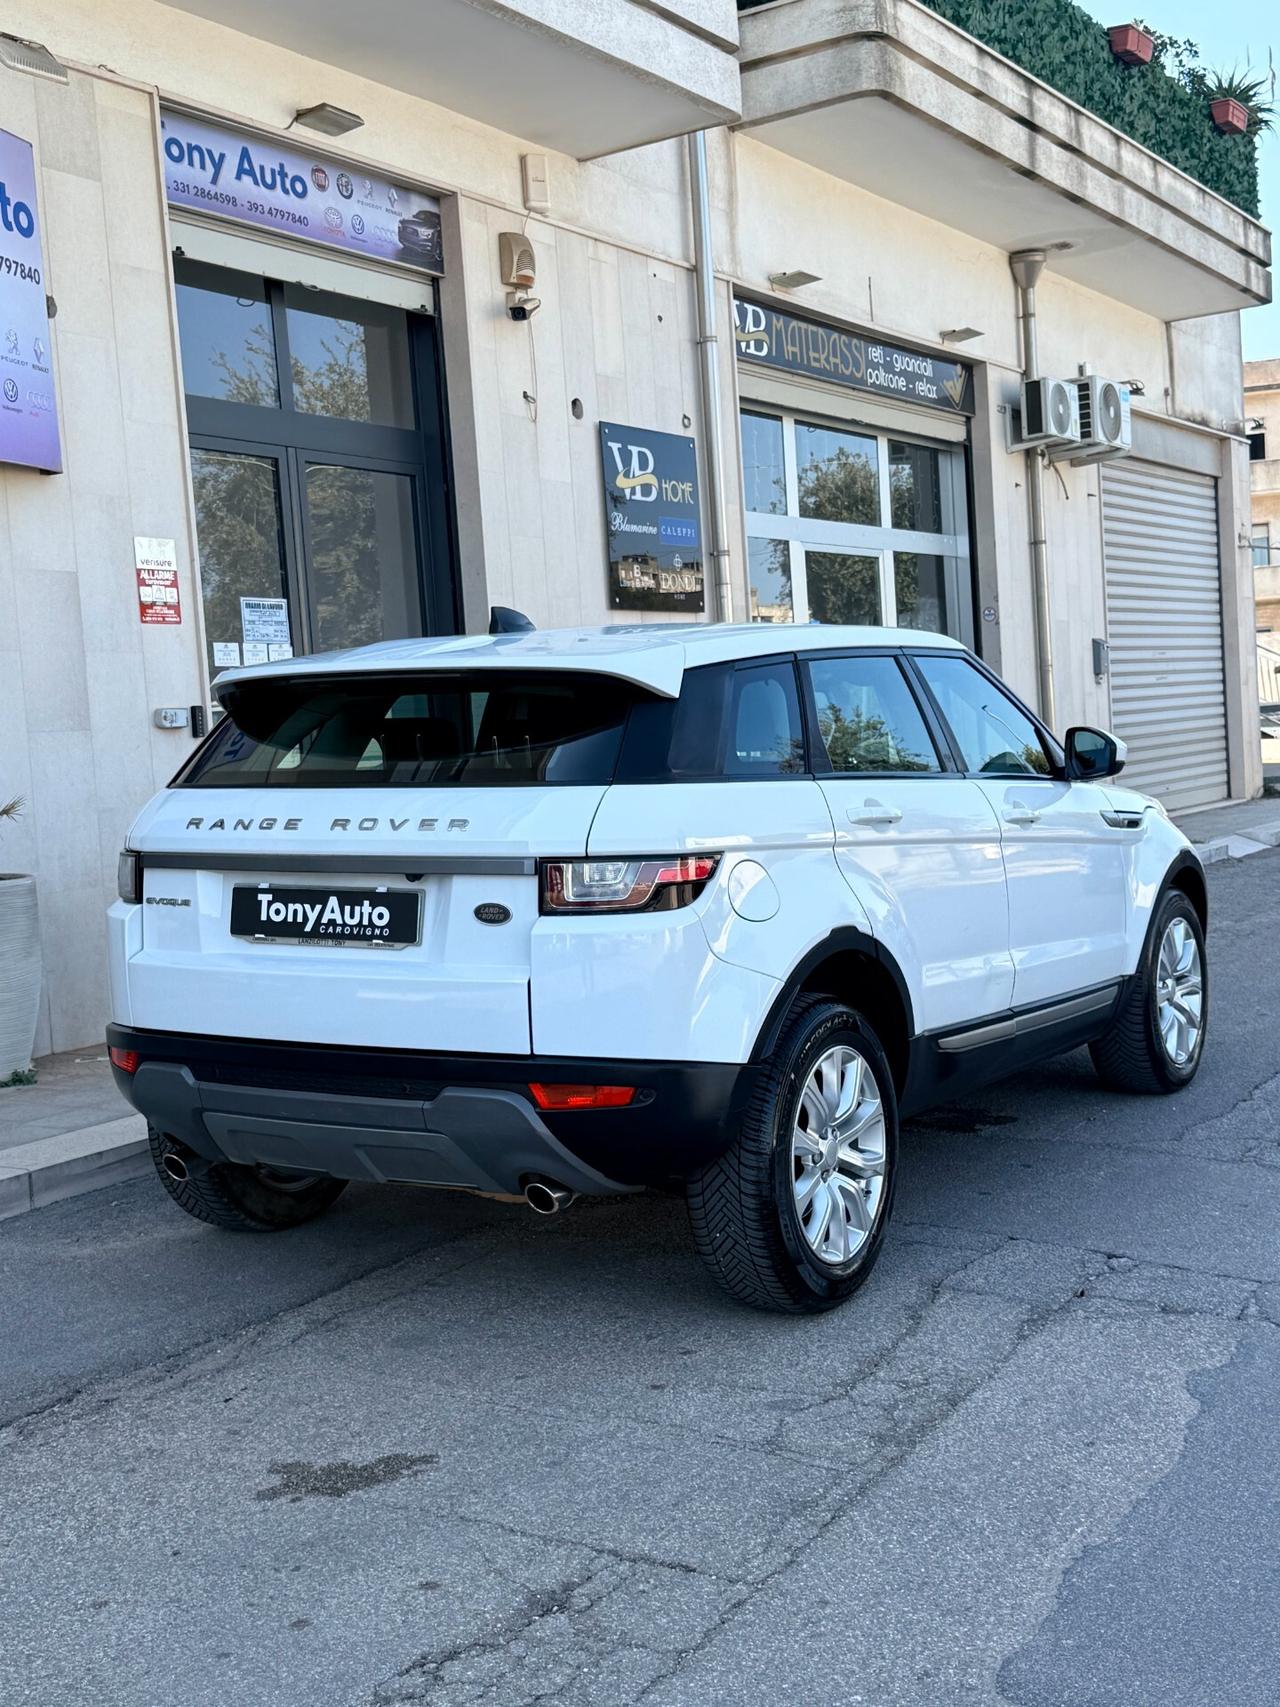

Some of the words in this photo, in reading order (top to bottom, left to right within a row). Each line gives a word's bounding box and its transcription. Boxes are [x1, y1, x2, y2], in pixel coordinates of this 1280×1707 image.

[161, 120, 226, 186] ony
[235, 146, 308, 199] Auto
[173, 180, 190, 195] 331
[193, 185, 238, 208] 2864598
[246, 201, 265, 215] 393
[267, 207, 310, 227] 4797840
[772, 314, 866, 379] MATERASSI
[868, 345, 884, 364] reti
[893, 353, 934, 377] guanciali
[867, 366, 907, 391] poltrone
[915, 378, 938, 399] relax
[662, 478, 694, 504] HOME
[611, 511, 658, 535] Blumarine
[139, 569, 175, 580] ALLARME
[140, 559, 172, 567] verisure
[186, 817, 303, 831] RANGE
[330, 818, 470, 832] ROVER
[319, 925, 390, 937] CAROVIGNO
